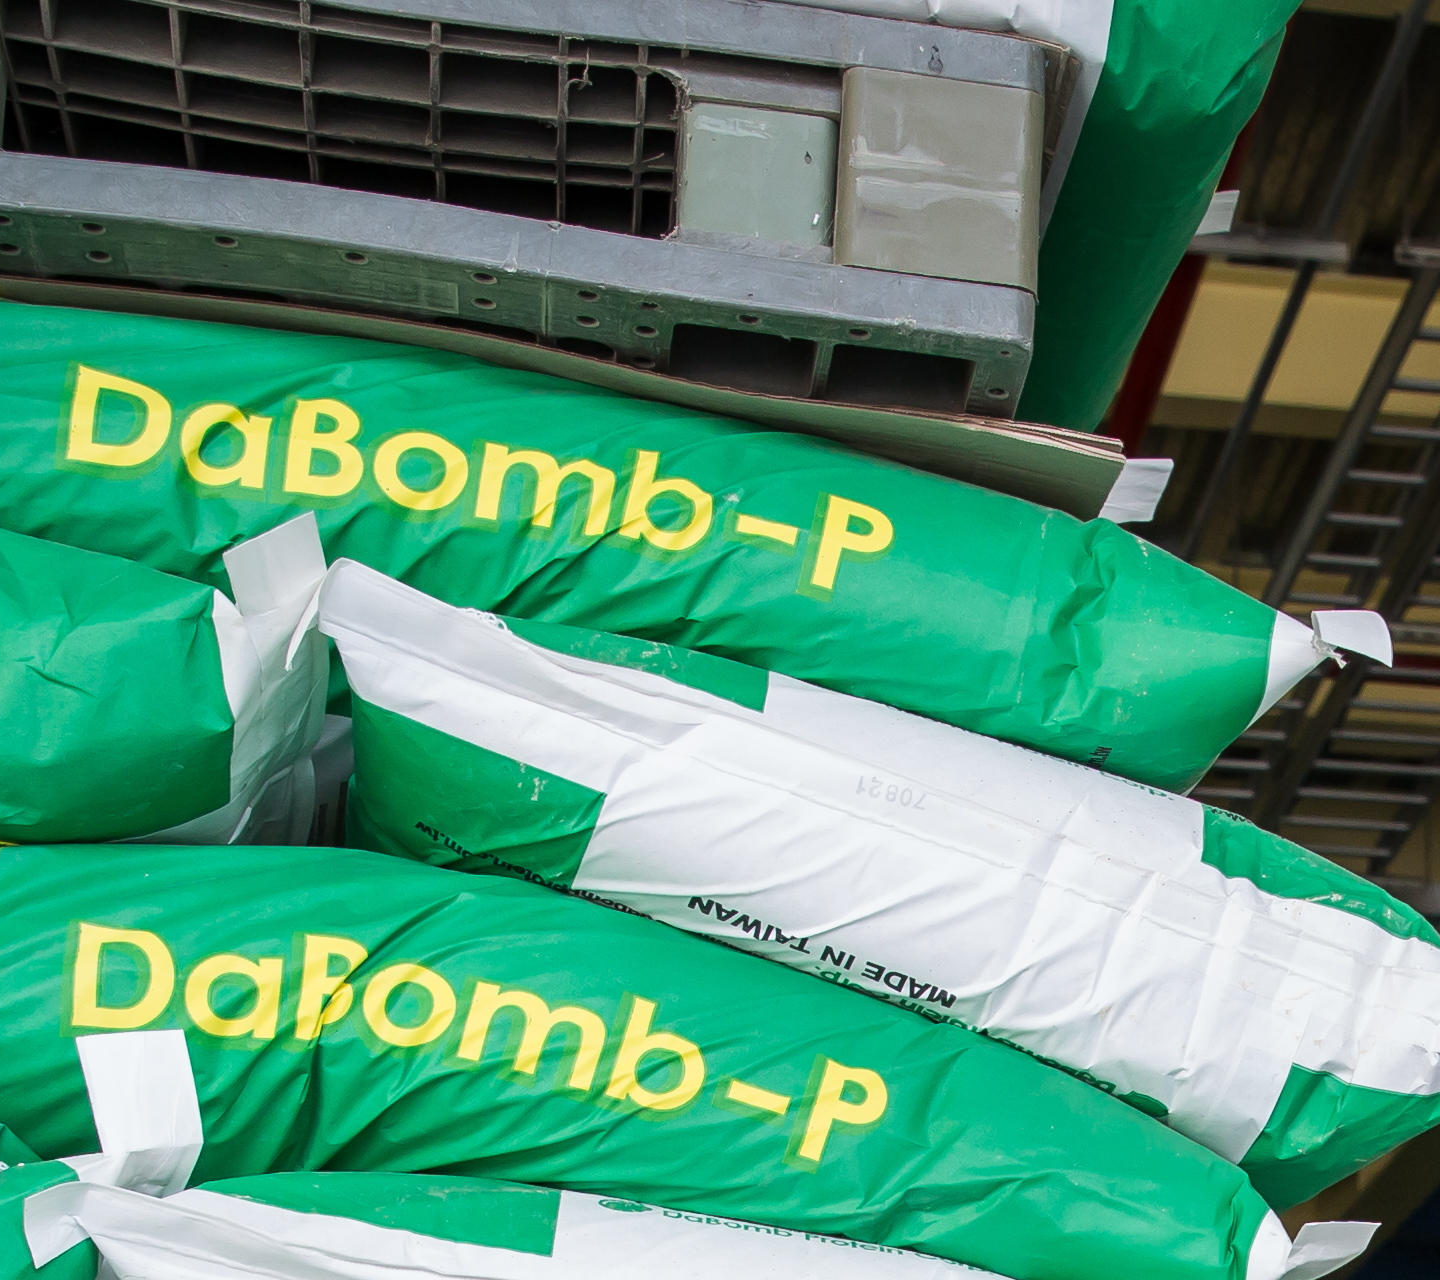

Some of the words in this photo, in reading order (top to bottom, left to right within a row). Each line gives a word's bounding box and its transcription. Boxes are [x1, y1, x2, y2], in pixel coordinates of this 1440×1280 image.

[66, 365, 894, 589] DaBomb-P
[855, 774, 927, 812] 70821
[686, 894, 813, 956] TAIWAN
[818, 943, 857, 974] IN
[862, 961, 957, 1010] MADE
[70, 925, 888, 1161] DaBomb-P
